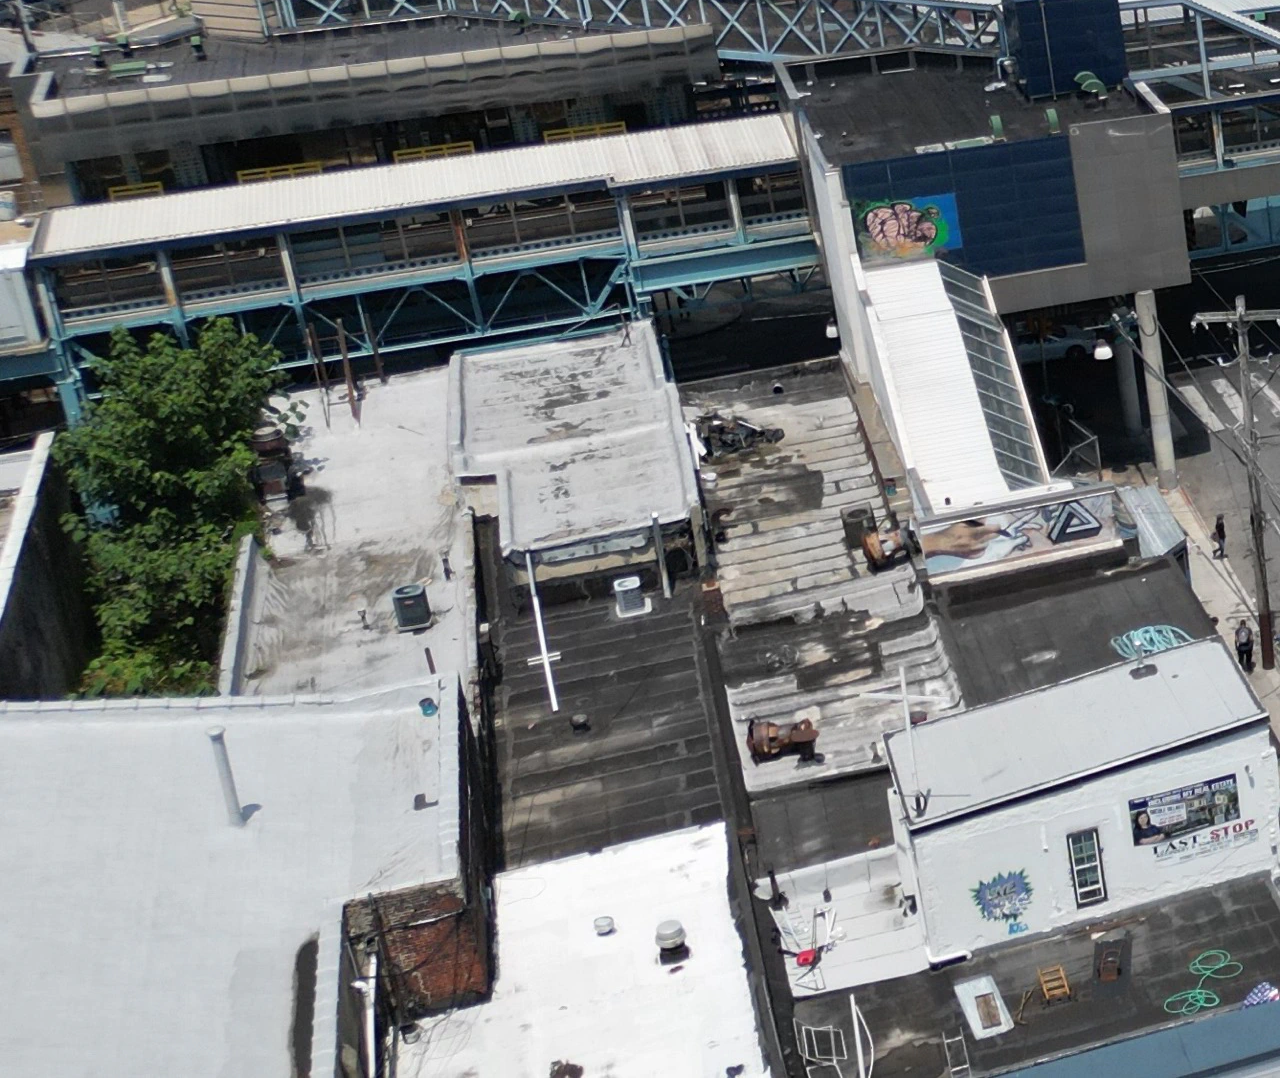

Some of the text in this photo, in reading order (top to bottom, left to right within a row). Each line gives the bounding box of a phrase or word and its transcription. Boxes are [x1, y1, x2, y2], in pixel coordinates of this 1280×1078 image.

[1182, 789, 1193, 798] MY
[1194, 786, 1209, 795] REAL
[1211, 779, 1234, 791] ESTATE
[1152, 835, 1198, 854] LAST
[1210, 819, 1255, 839] STOP
